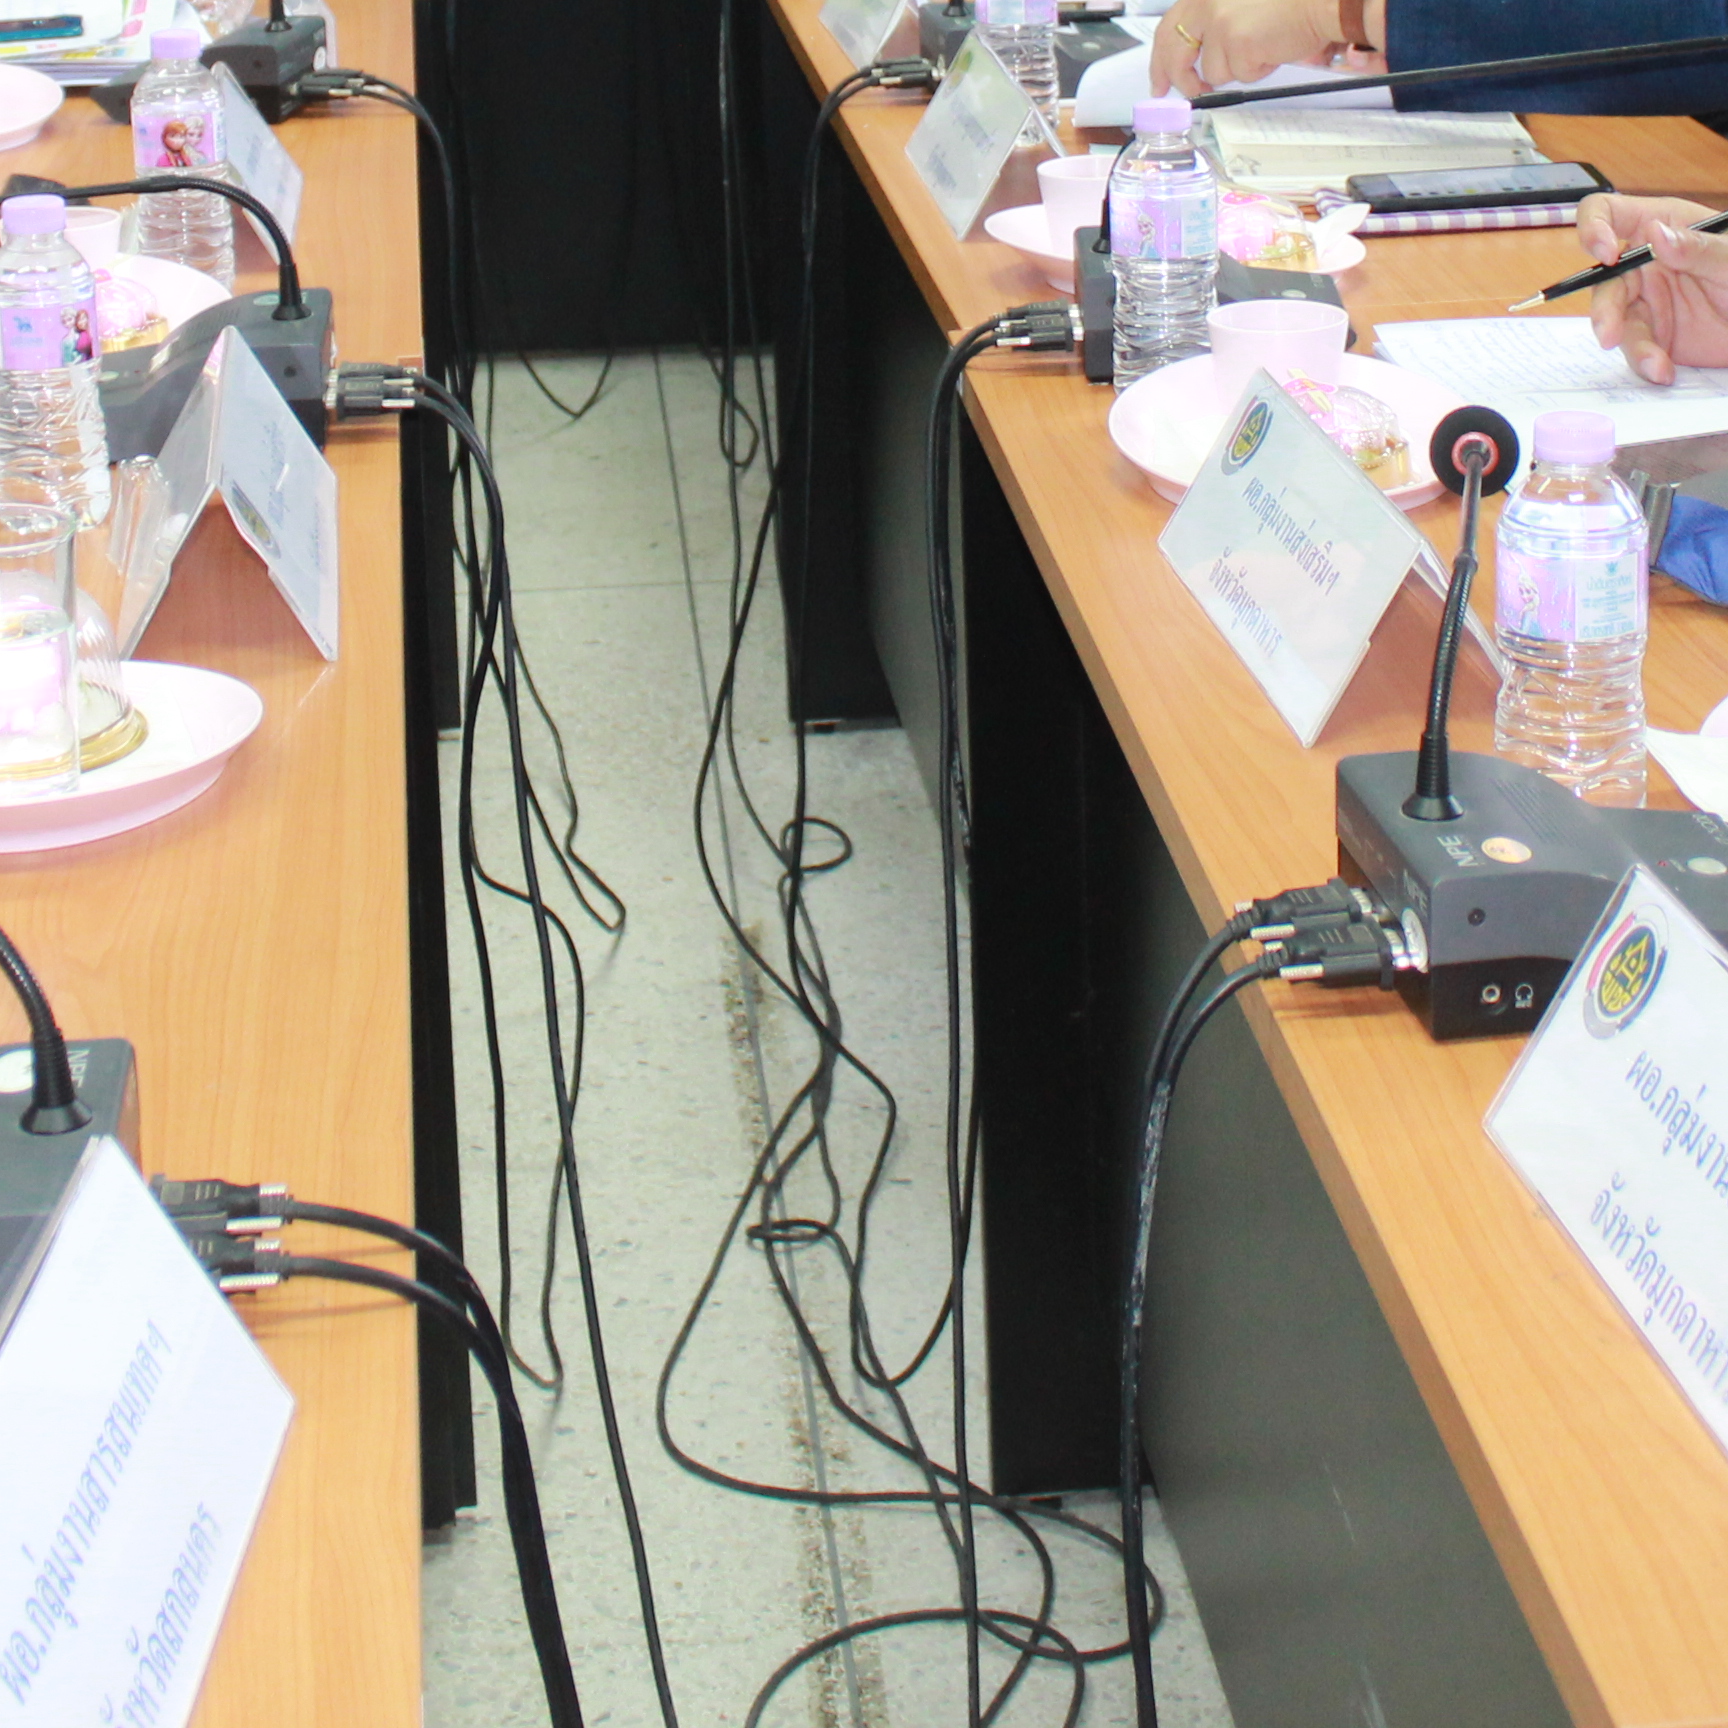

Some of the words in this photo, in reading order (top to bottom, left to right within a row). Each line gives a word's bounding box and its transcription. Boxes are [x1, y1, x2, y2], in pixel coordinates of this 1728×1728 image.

[1242, 475, 1341, 596] ผอ.กลุ่มงานส่งเสริมฯ
[1208, 546, 1284, 656] จังหวัดมุกดาหาร
[1436, 834, 1480, 868] NPE
